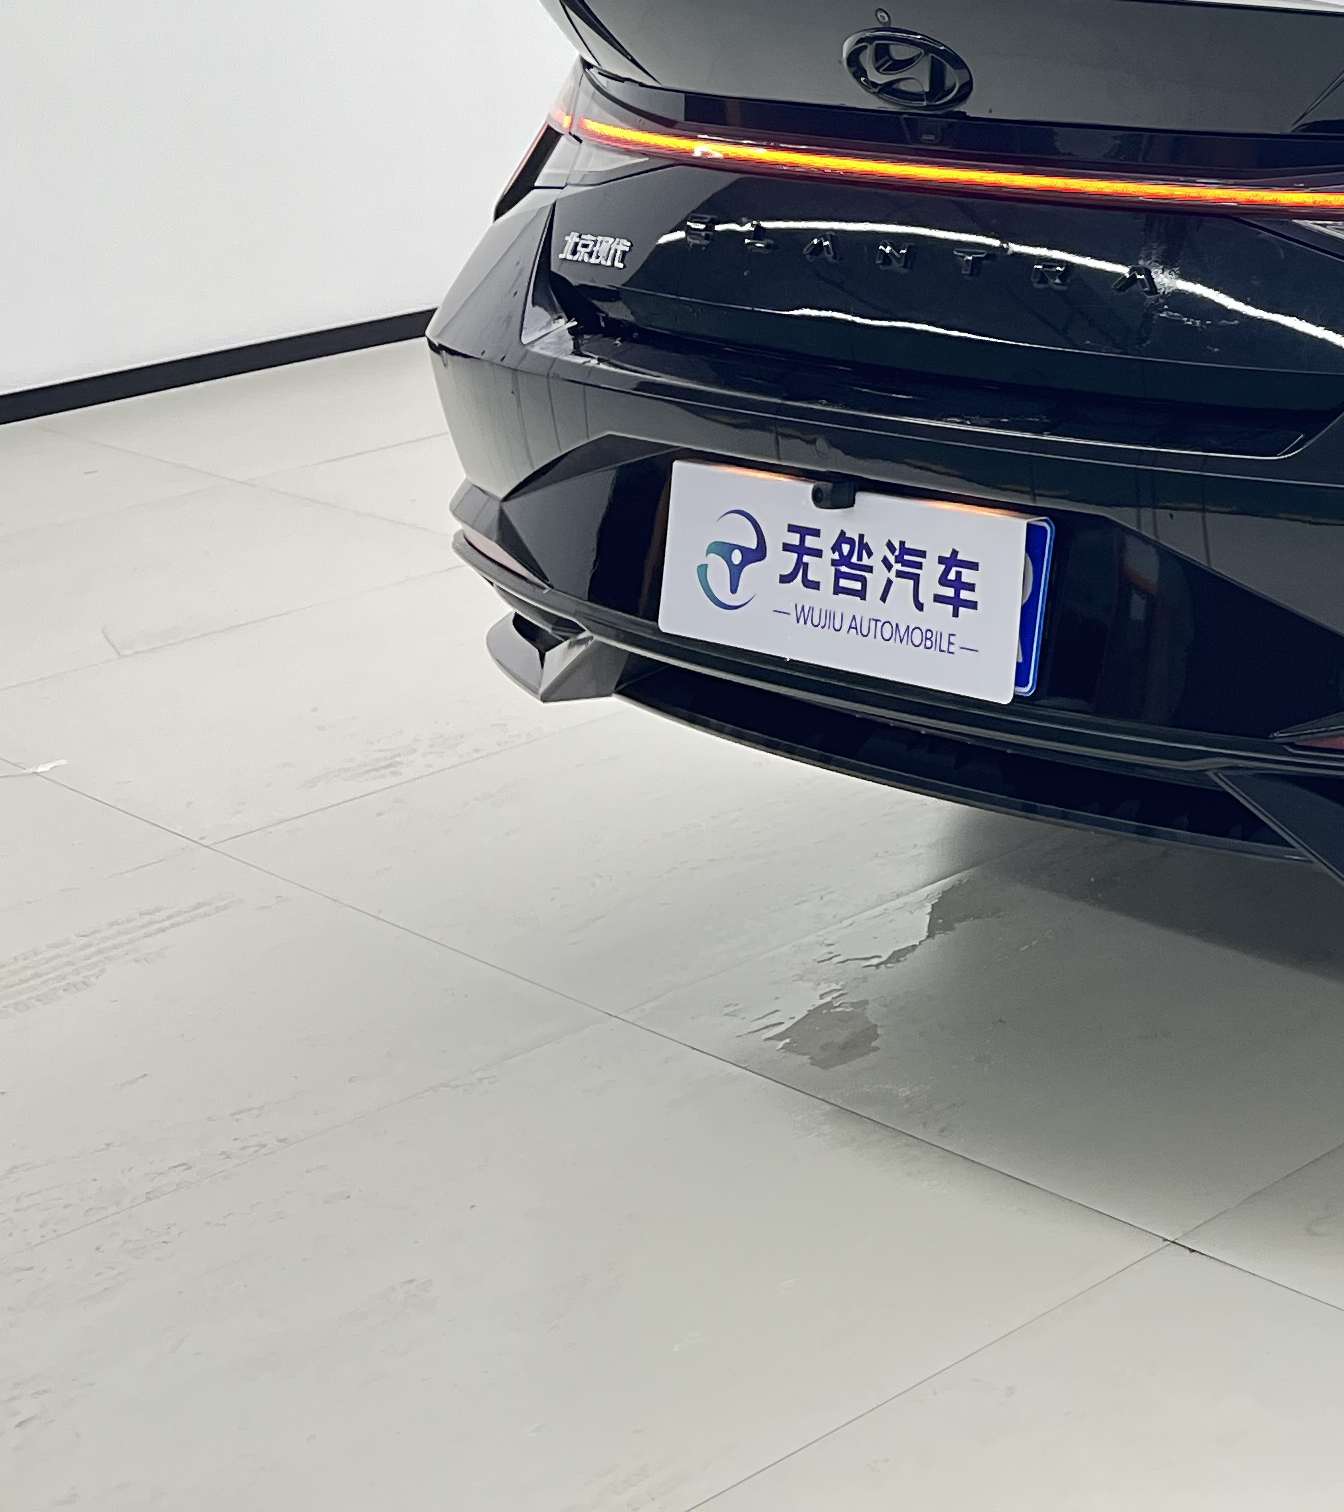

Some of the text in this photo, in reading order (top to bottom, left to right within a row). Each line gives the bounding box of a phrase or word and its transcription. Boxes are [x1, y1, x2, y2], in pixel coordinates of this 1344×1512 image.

[558, 231, 633, 269] 北京现代
[685, 214, 1160, 297] ELANTRA
[778, 523, 980, 619] 无咎汽车
[794, 603, 956, 655] WUJIU AUTOMOBILE
